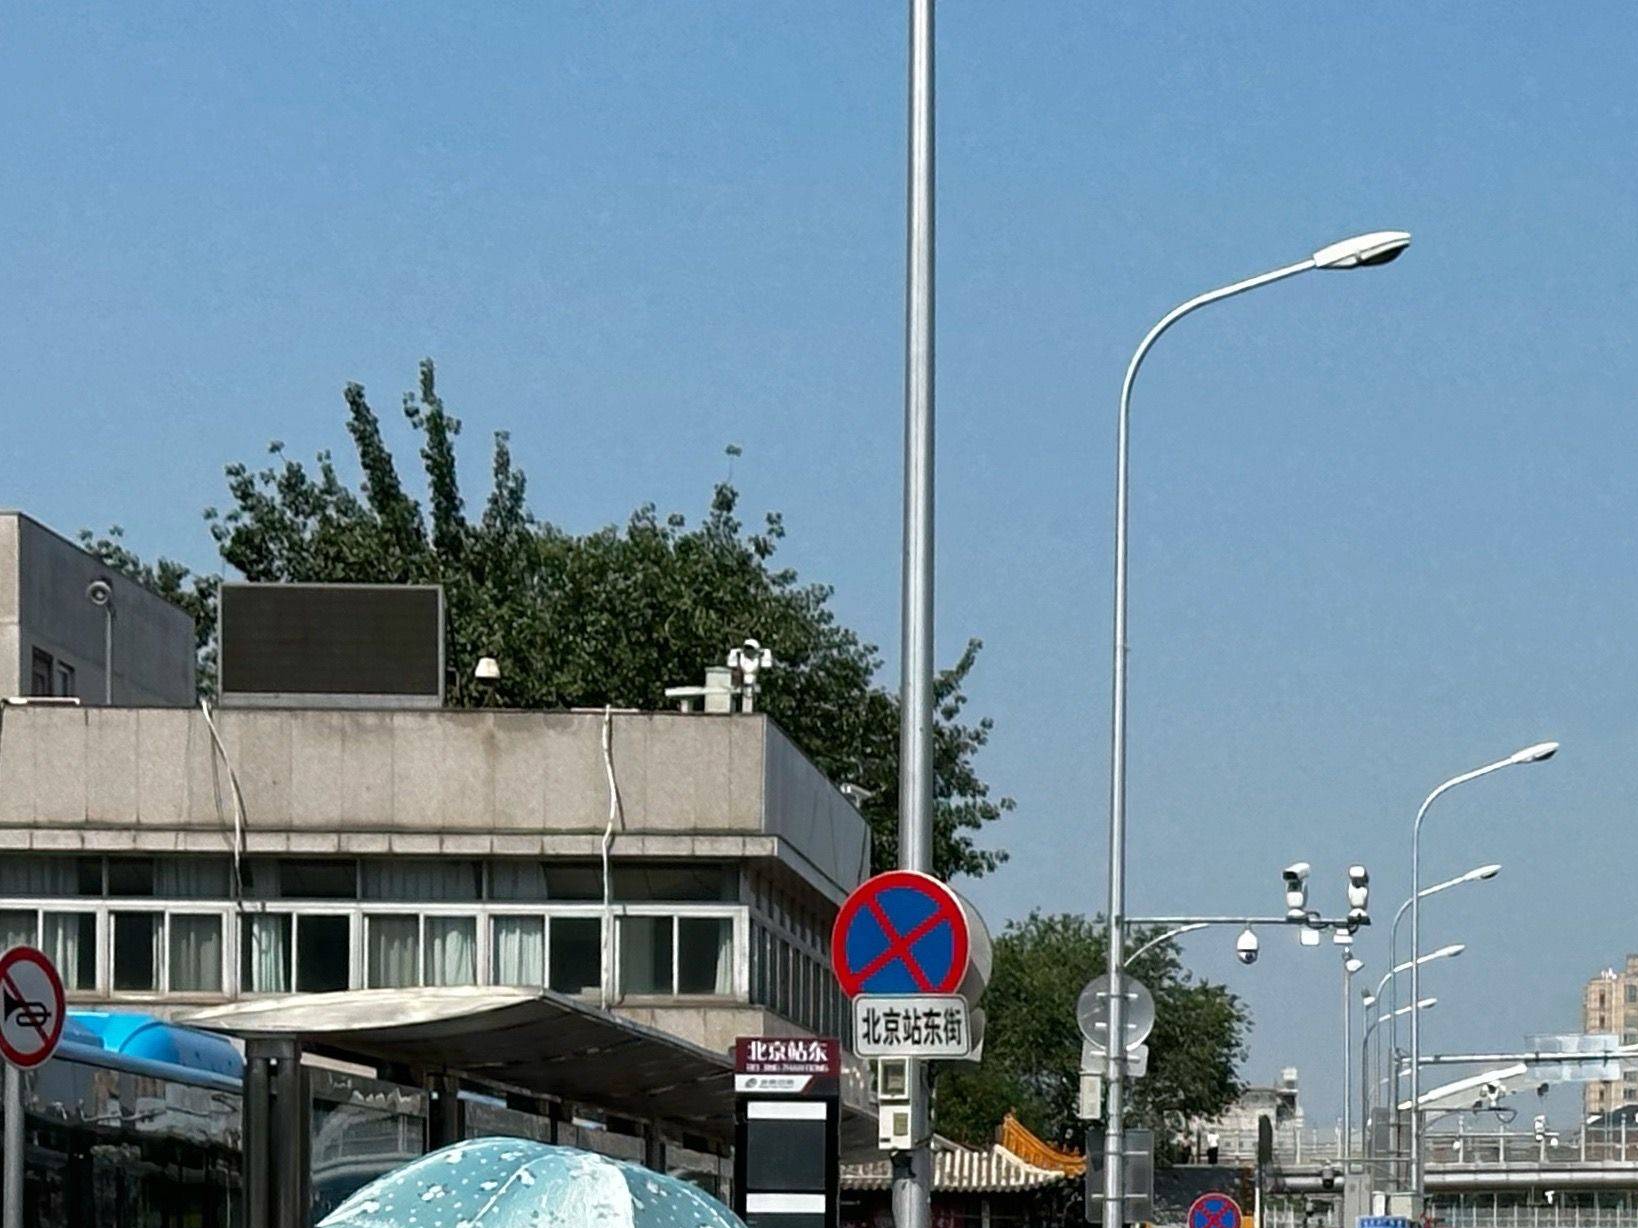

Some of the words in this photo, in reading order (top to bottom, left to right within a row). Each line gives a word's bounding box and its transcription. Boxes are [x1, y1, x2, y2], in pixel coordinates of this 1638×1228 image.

[862, 1007, 962, 1046] 北京站东街
[747, 1040, 828, 1062] 北京站东
